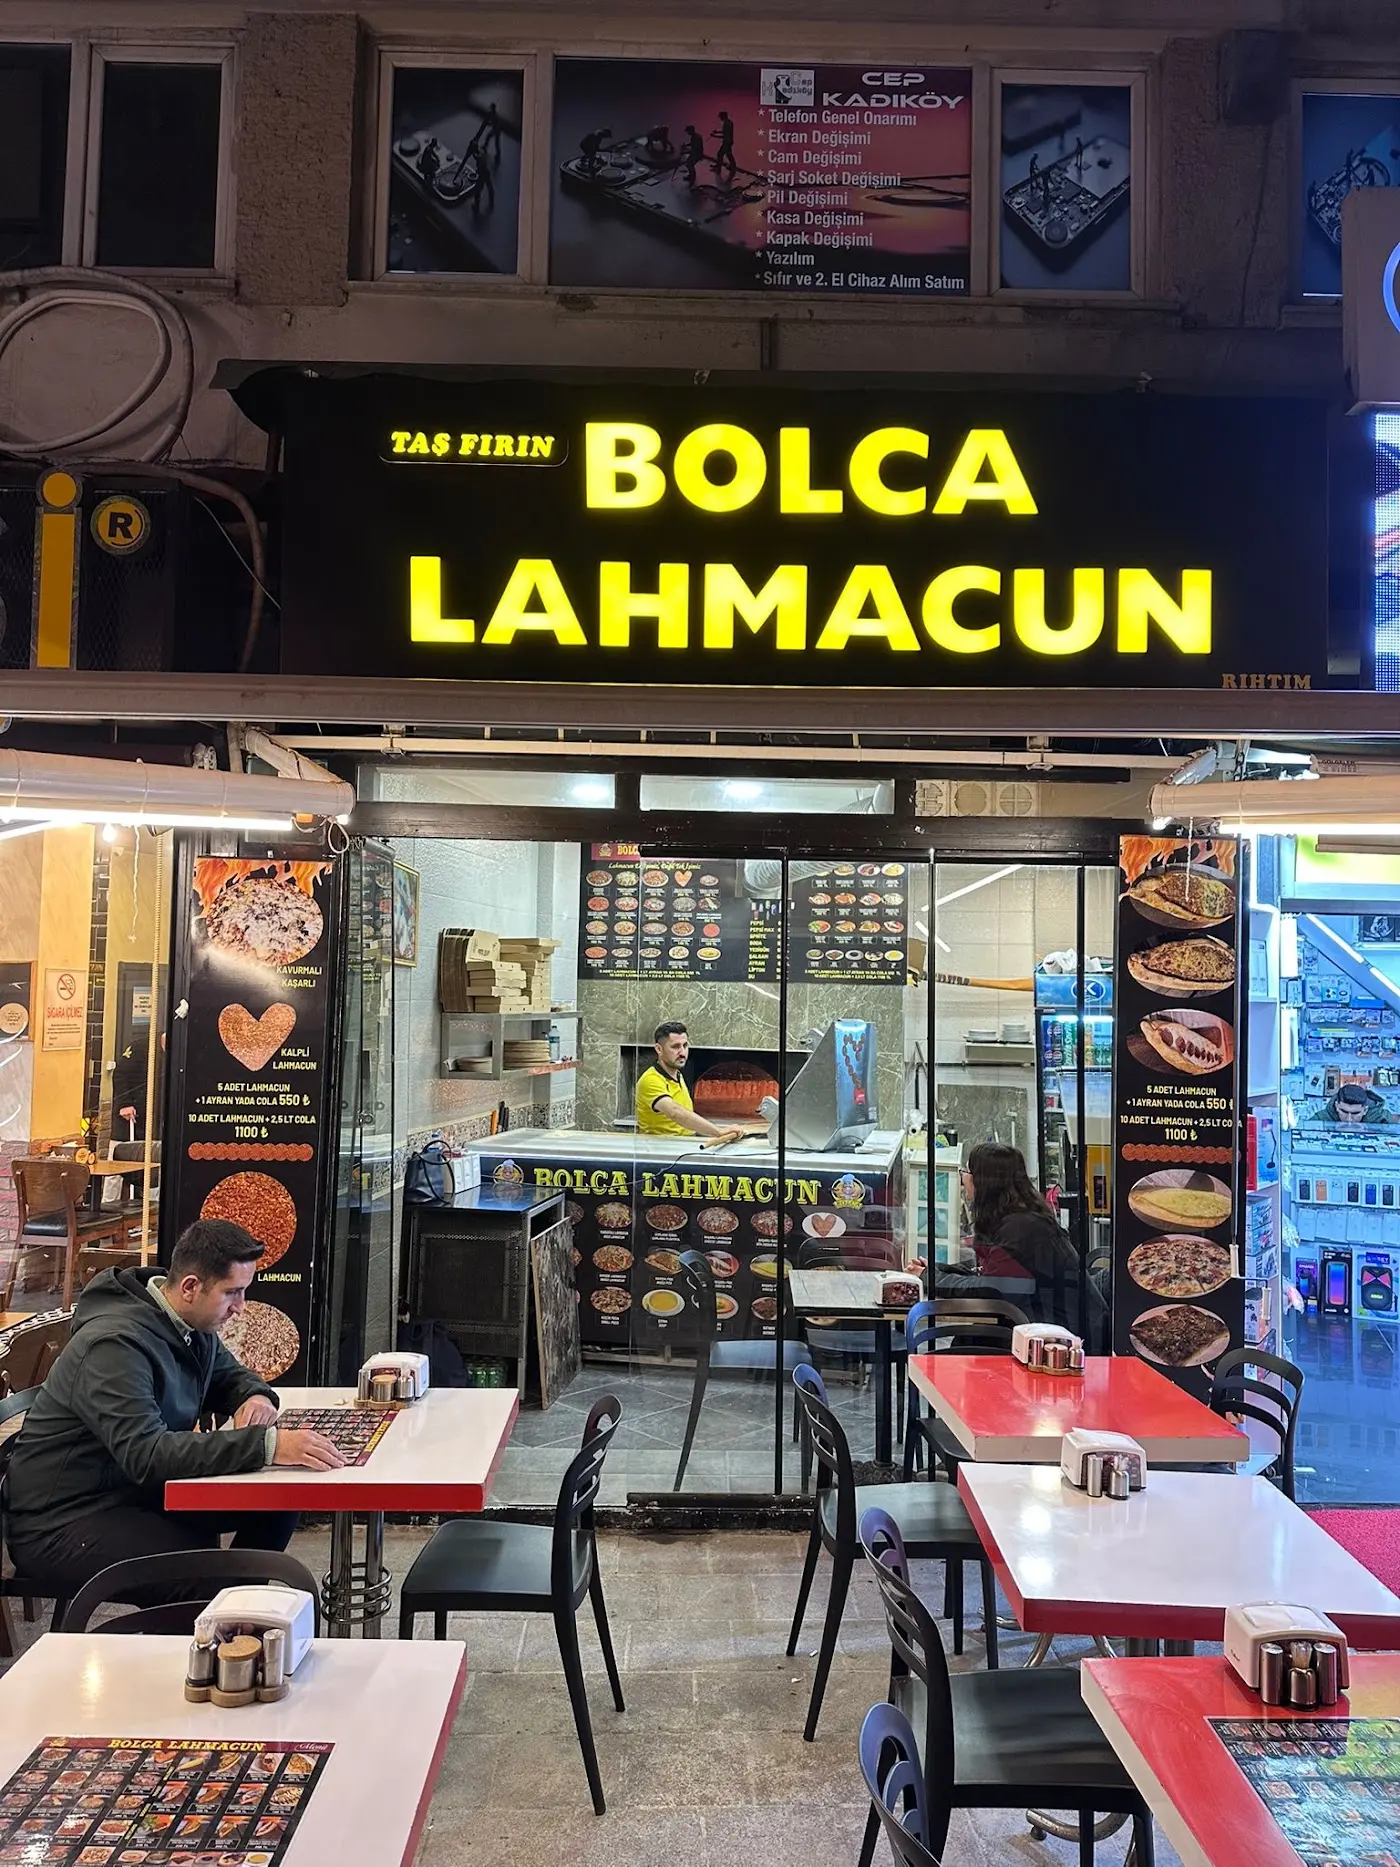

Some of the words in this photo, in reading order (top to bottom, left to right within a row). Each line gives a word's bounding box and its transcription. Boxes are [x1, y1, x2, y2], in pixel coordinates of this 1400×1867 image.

[861, 72, 926, 87] CEP
[822, 91, 965, 109] KADIKÖY
[768, 109, 817, 124] Telefon
[822, 110, 860, 125] Genel
[864, 112, 917, 126] Onarımı
[768, 129, 808, 144] Ekran
[812, 131, 871, 148] Değişimi
[768, 149, 799, 164] Cam
[803, 151, 862, 168] Değişimi
[767, 170, 795, 188] Şarj
[799, 171, 838, 185] Soket
[841, 172, 901, 190] Değişimi
[767, 190, 784, 204] Pil
[788, 190, 848, 208] Değişimi
[767, 210, 800, 225] Kasa
[804, 212, 864, 229] Değişimi
[766, 231, 810, 248] Kapak
[813, 232, 873, 250] Değişimi
[766, 251, 815, 266] Yazılım
[763, 271, 793, 286] Sıfır
[796, 275, 812, 286] ve
[815, 272, 828, 286] 2.
[831, 273, 844, 286] El
[848, 273, 886, 288] Cihaz
[889, 274, 921, 288] Alım
[924, 275, 965, 289] Satım
[391, 431, 451, 456] TAŞ
[459, 434, 555, 457] FIRIN
[585, 422, 1038, 515] BOLCA
[410, 556, 1212, 655] LAHMACUN
[1222, 673, 1312, 690] RIHTIM
[617, 844, 640, 856] BOLC
[276, 965, 322, 975] KAVURMALI
[281, 979, 316, 988] KAŞARLI
[281, 1047, 310, 1058] KALPLİ
[273, 1061, 317, 1070] LAHMACUN
[217, 1083, 223, 1091] 5
[224, 1083, 246, 1092] ADET
[246, 1083, 290, 1092] LAHMACUN
[1146, 1085, 1152, 1093] 5
[1153, 1085, 1173, 1094] ADET
[1174, 1086, 1217, 1096] LAHMACUN
[206, 1096, 233, 1105] AYRAN
[235, 1096, 255, 1105] YADA
[256, 1097, 278, 1106] COLA
[279, 1094, 300, 1106] 550
[1136, 1098, 1162, 1107] AYRAN
[1163, 1099, 1183, 1108] YADA
[1184, 1100, 1205, 1109] COLA
[1206, 1098, 1226, 1110] 550
[188, 1114, 196, 1123] 10
[197, 1114, 219, 1123] ADET
[220, 1114, 264, 1123] LAHMACUN
[284, 1115, 294, 1124] LT
[294, 1115, 316, 1124] COLA
[1120, 1115, 1129, 1124] 10
[1129, 1116, 1150, 1125] ADET
[1150, 1116, 1193, 1126] LAHMACUN
[1212, 1118, 1221, 1127] LT
[1222, 1119, 1243, 1128] COA
[234, 1126, 258, 1138] 1100
[1165, 1128, 1187, 1141] 1100
[534, 1167, 630, 1196] BOLCA
[257, 1272, 302, 1283] LAHMACUN
[108, 1739, 165, 1750] BOLCA
[168, 1740, 266, 1752] LAHMACUN
